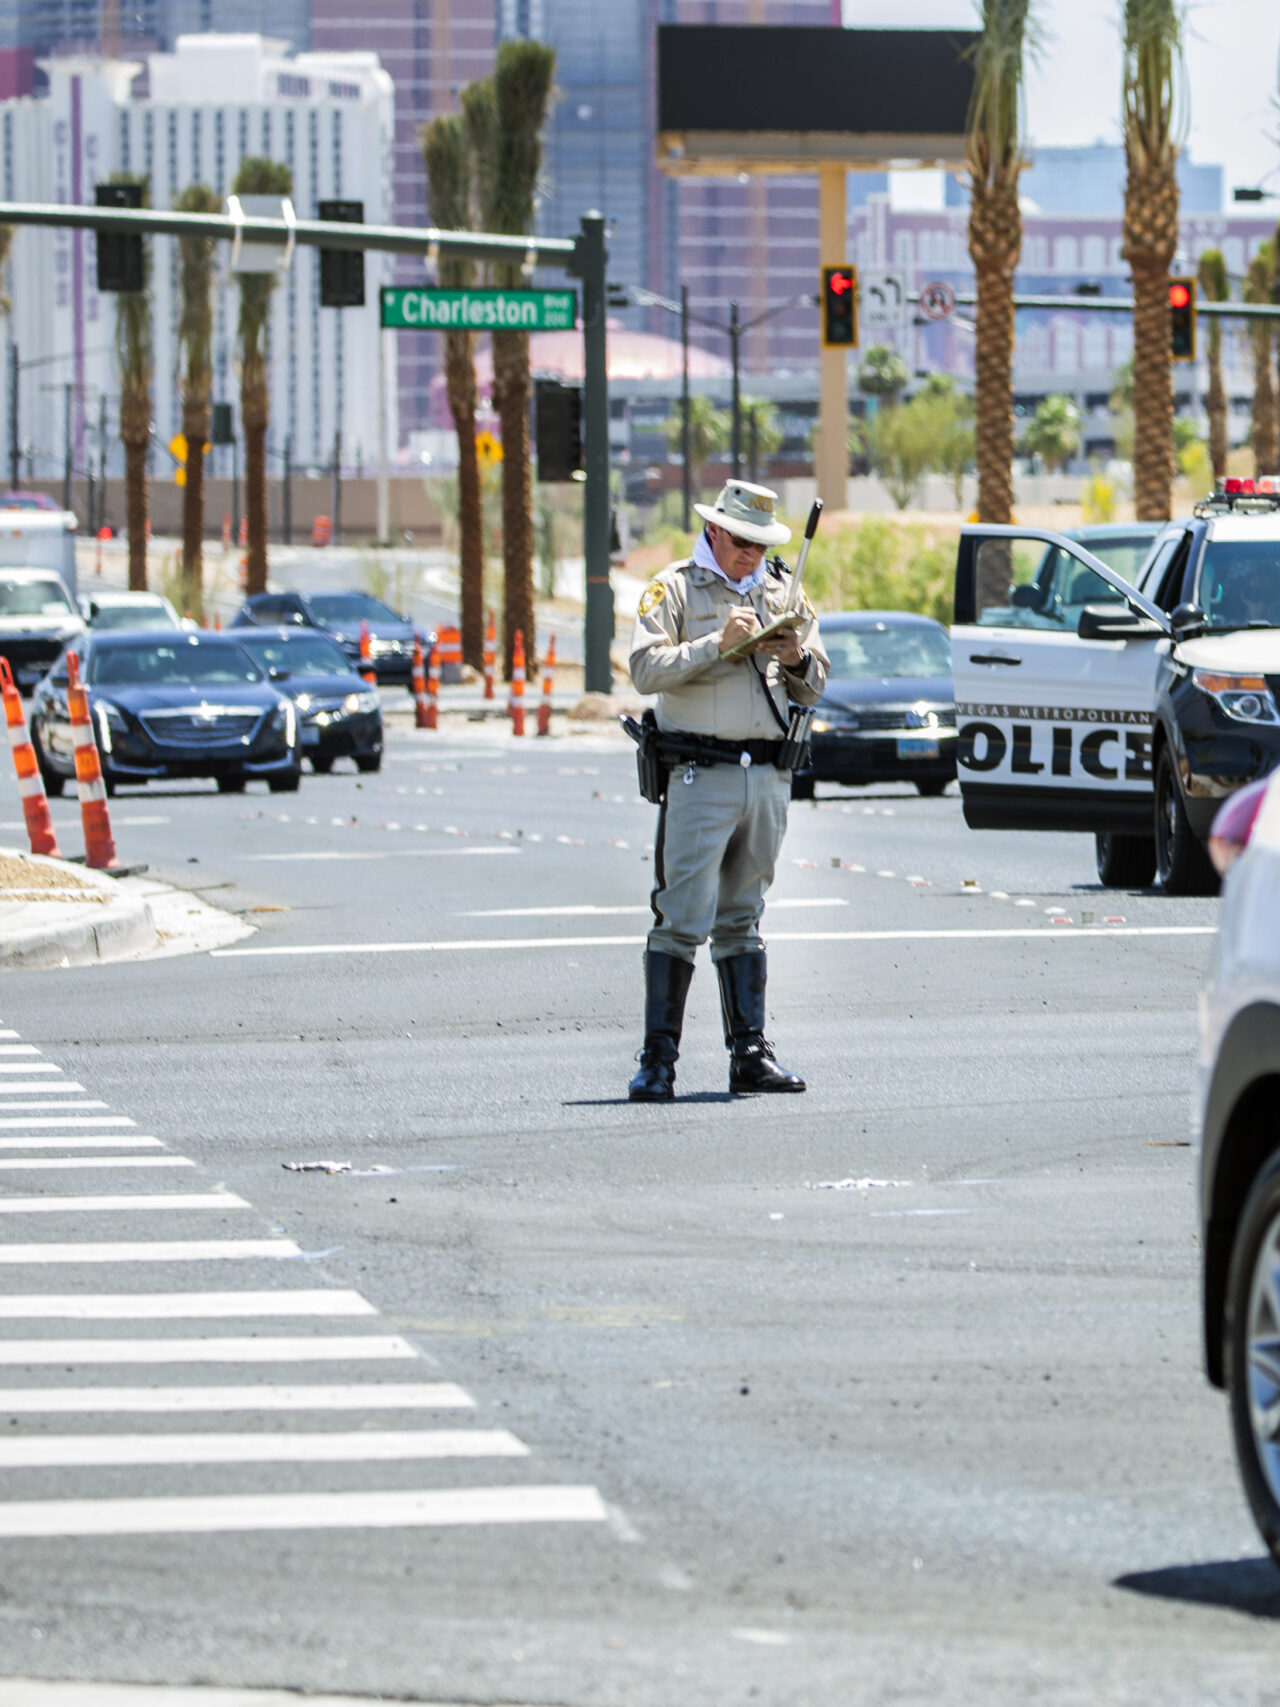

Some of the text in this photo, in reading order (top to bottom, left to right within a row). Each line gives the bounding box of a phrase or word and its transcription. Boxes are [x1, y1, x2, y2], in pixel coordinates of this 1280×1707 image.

[402, 292, 537, 325] Charleston
[957, 704, 1150, 723] VEGAS METROPOLITAN
